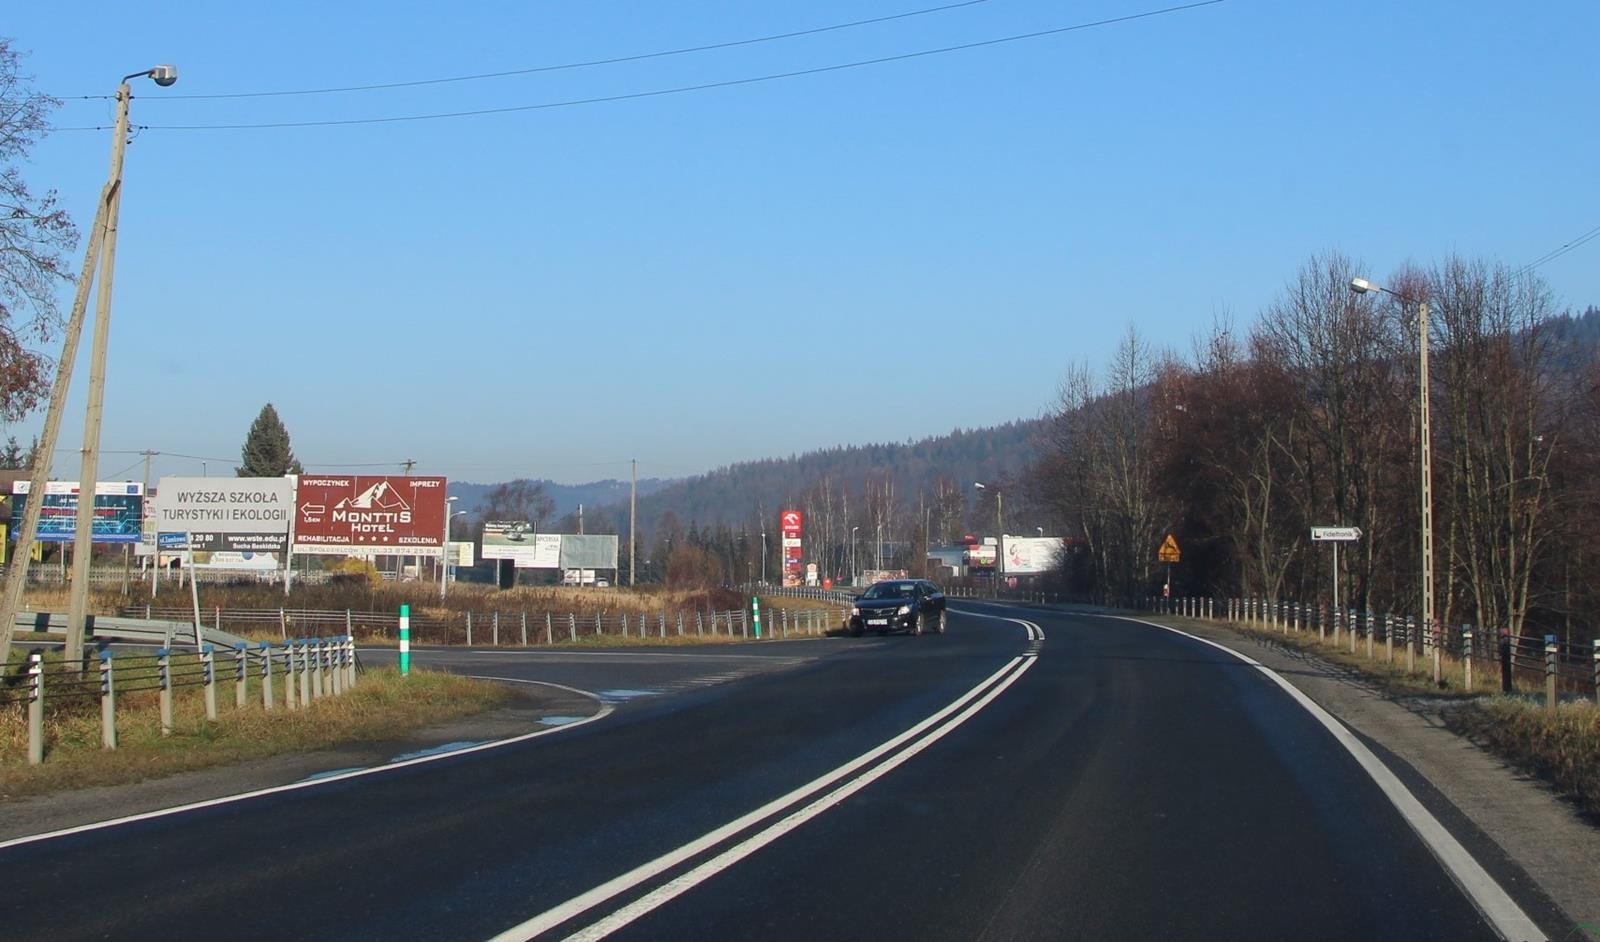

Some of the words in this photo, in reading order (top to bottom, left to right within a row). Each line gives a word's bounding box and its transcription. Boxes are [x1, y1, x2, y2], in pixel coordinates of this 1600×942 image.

[177, 490, 226, 503] WYŻSZA
[230, 491, 278, 503] SZKOŁA
[163, 508, 223, 520] TURYSTYKI
[226, 509, 230, 520] I
[232, 508, 287, 520] EKOLOGII
[332, 510, 412, 523] MONTTIS
[204, 534, 214, 542] 80
[228, 535, 286, 543] www.wste.edu.pl
[297, 535, 350, 543] REHABILITACJA
